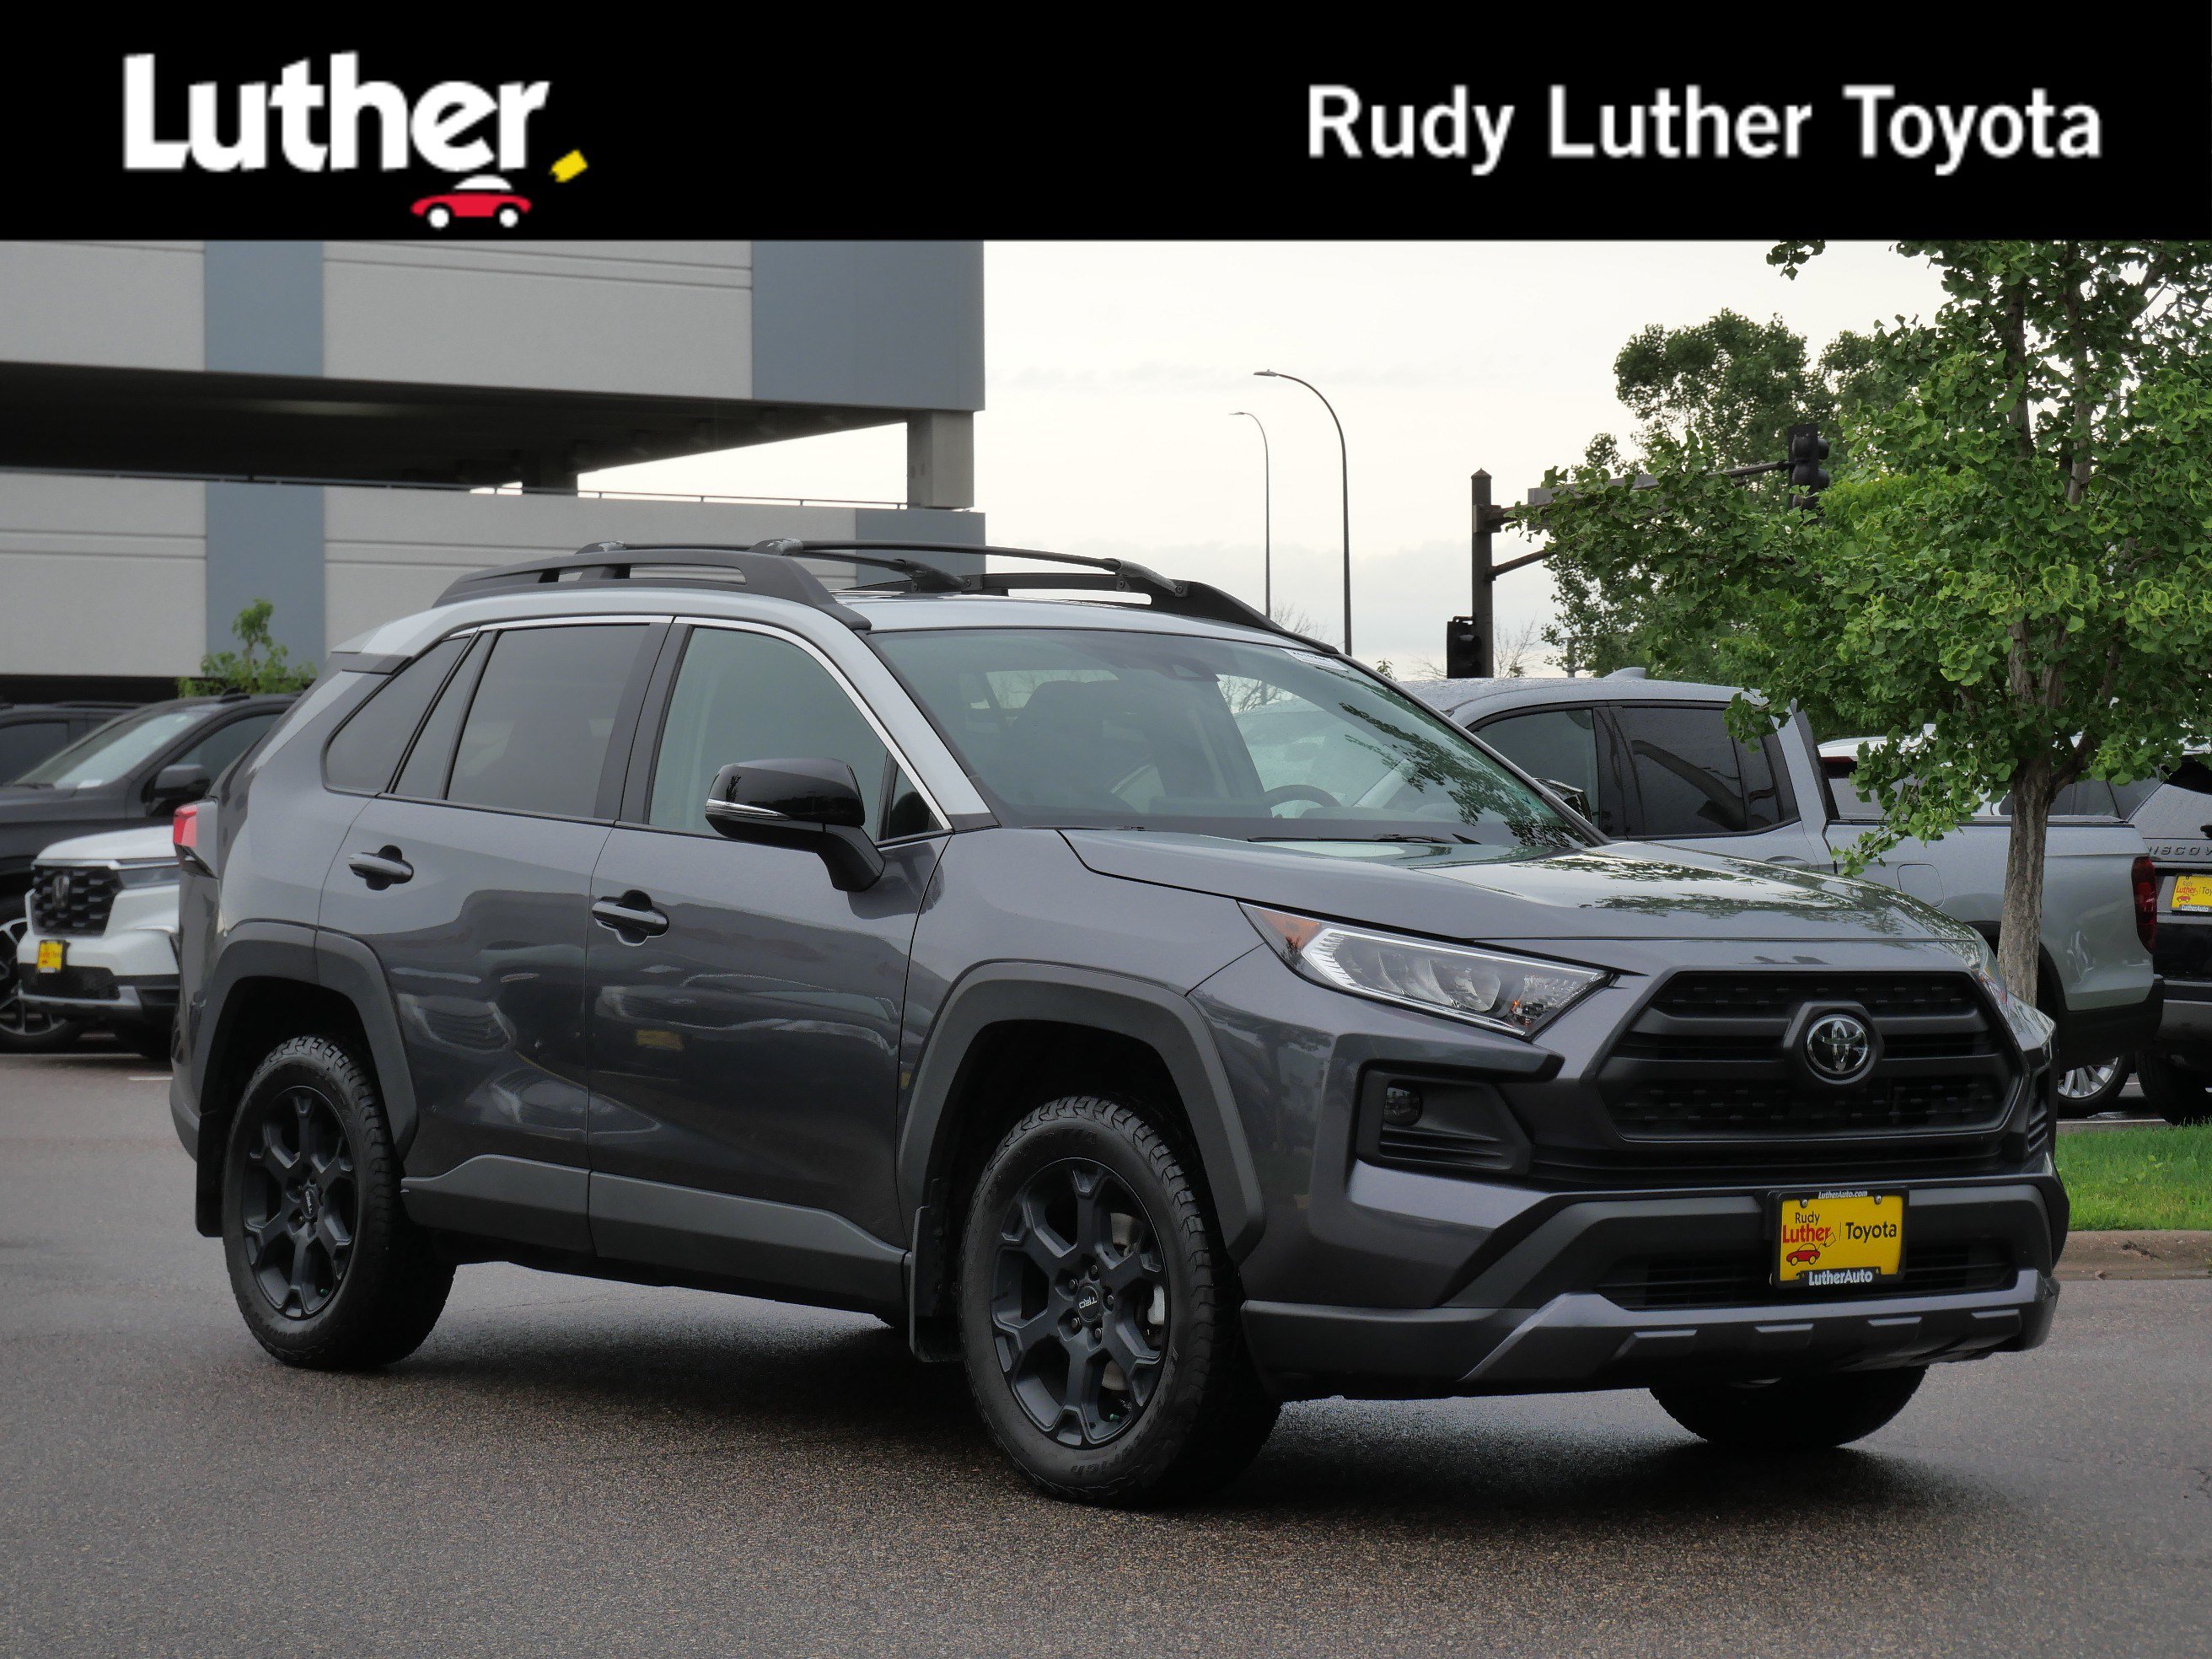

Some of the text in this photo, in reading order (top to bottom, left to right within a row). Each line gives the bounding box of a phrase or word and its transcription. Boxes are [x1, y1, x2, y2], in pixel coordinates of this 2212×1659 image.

[1817, 1190, 1868, 1200] LutherAuto.com
[1795, 1210, 1821, 1227] Rudy
[1782, 1221, 1897, 1244] Luther Toyota
[1808, 1270, 1873, 1286] LutherAuto
